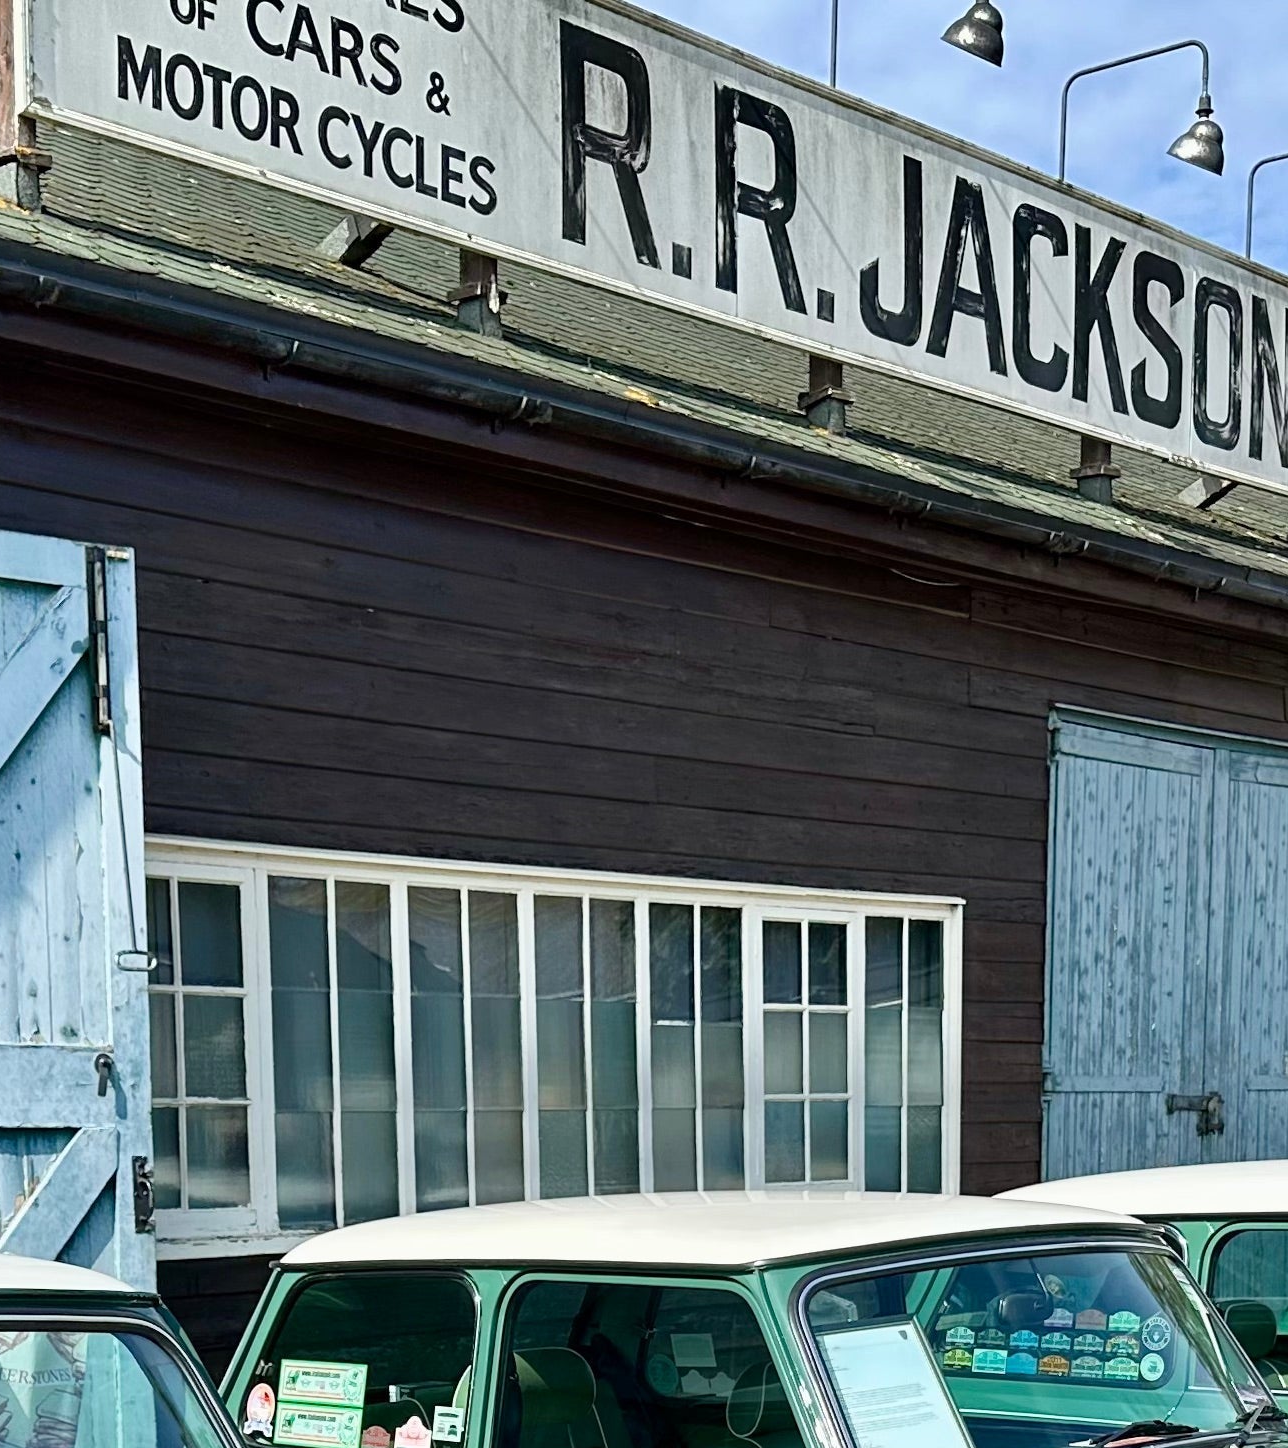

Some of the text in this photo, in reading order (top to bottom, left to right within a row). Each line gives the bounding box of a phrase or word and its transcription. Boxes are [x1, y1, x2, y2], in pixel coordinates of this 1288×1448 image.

[116, 34, 498, 216] MOTOR CYCLES
[246, 0, 403, 96] CARS
[425, 71, 451, 117] &
